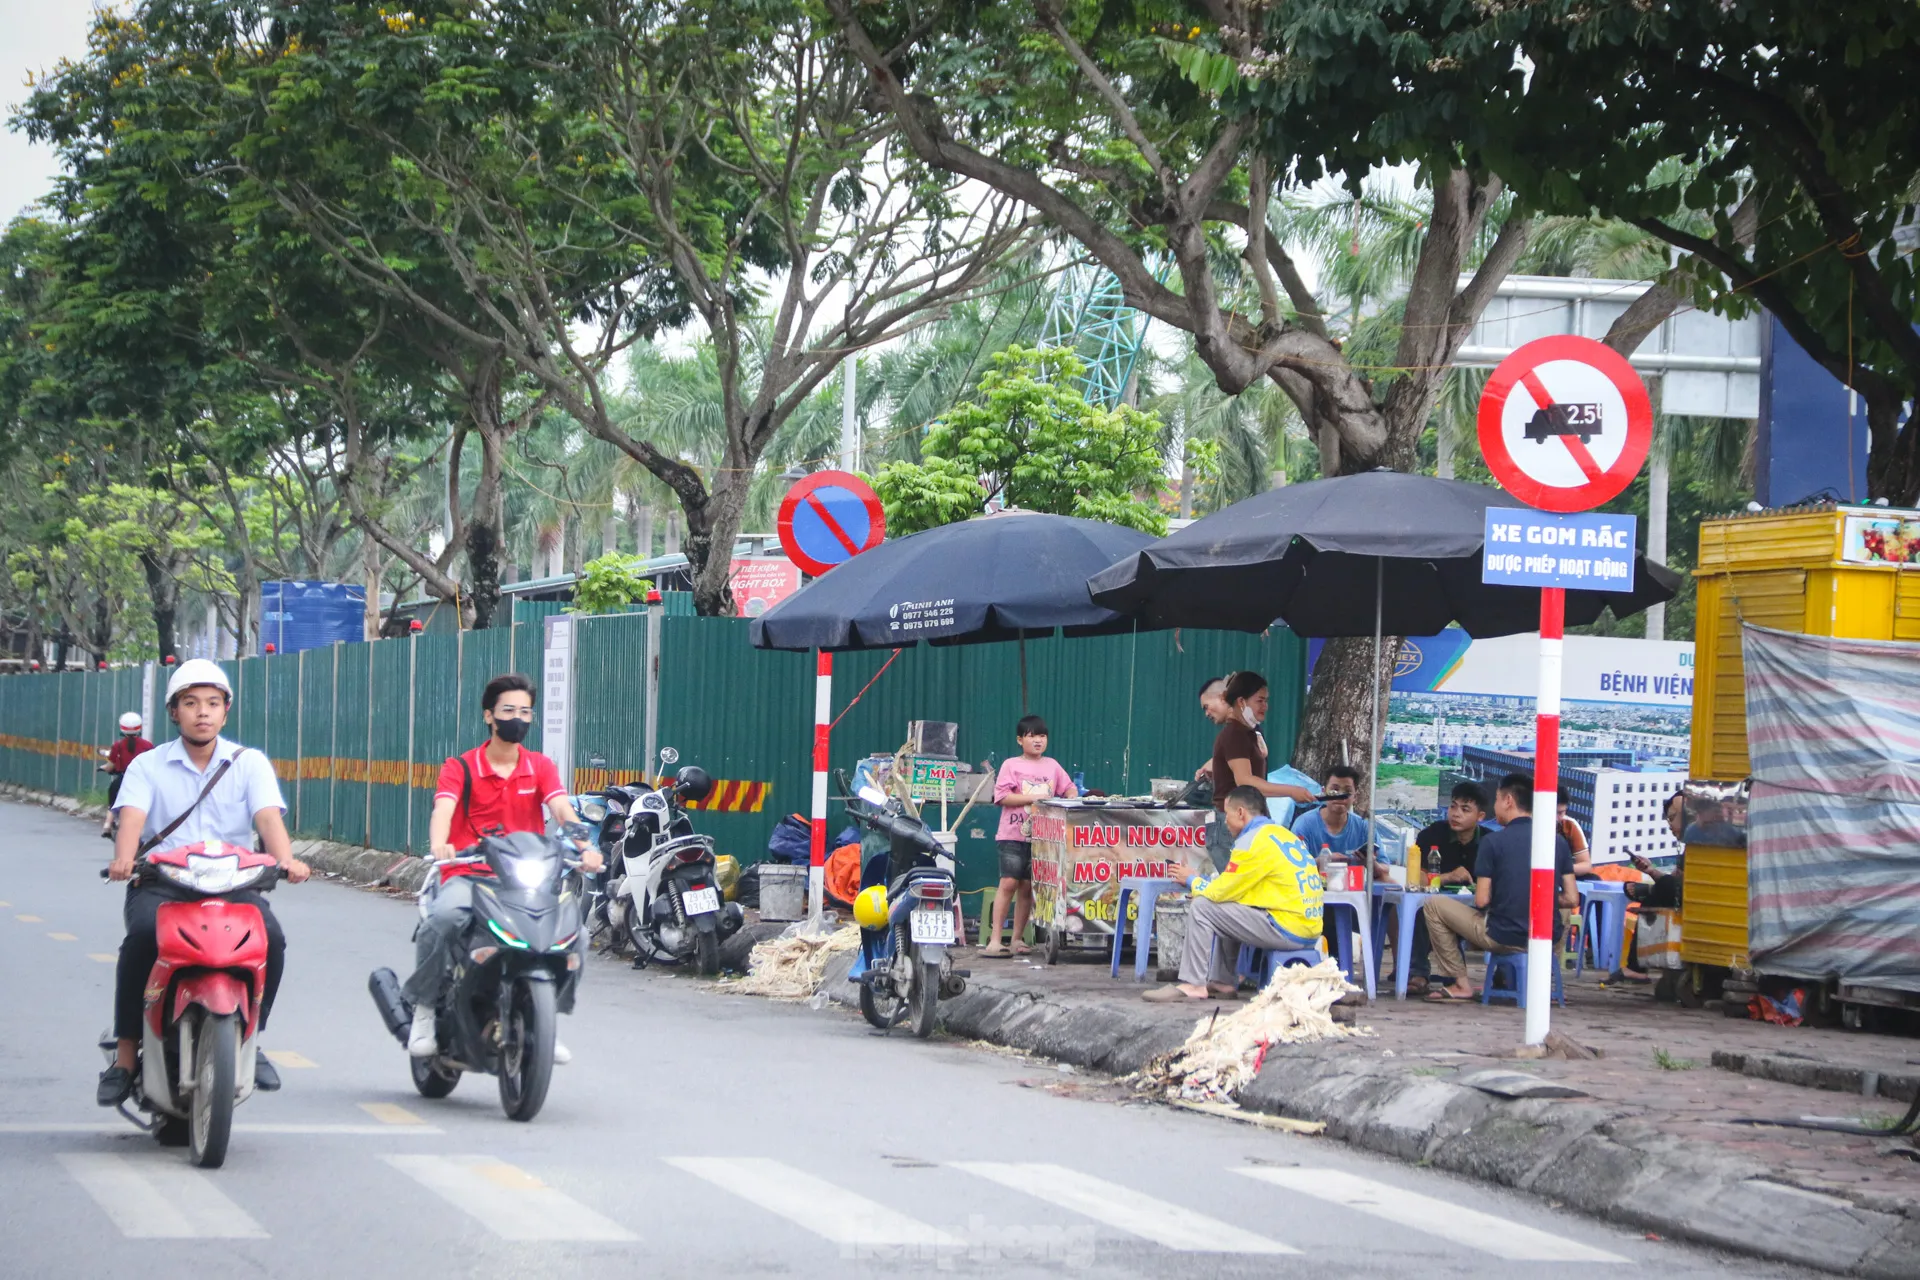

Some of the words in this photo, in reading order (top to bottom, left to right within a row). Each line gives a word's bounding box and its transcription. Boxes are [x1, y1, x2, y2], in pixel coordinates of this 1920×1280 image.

[1567, 403, 1602, 425] 2.5t
[1491, 523, 1522, 543] XE
[1526, 525, 1577, 546] GOM
[1581, 525, 1628, 549] RÁC
[1487, 554, 1522, 575] ĐƯỢC
[1524, 553, 1557, 574] PHÉP
[1559, 558, 1592, 579] HOẠT
[1593, 557, 1628, 581] ĐỘNG
[730, 579, 761, 590] LIGHT
[761, 578, 787, 588] BOX
[934, 598, 955, 608] ANH
[902, 611, 922, 620] 0977
[939, 607, 954, 616] 226
[903, 620, 923, 630] 0975
[924, 619, 939, 628] 079
[1600, 669, 1648, 696] BỆNH
[1653, 673, 1694, 699] VIỆN
[930, 765, 956, 780] MÍA
[1074, 821, 1121, 848] HÀU
[1127, 821, 1206, 848] NƯỚNG
[917, 925, 948, 937] 6175
